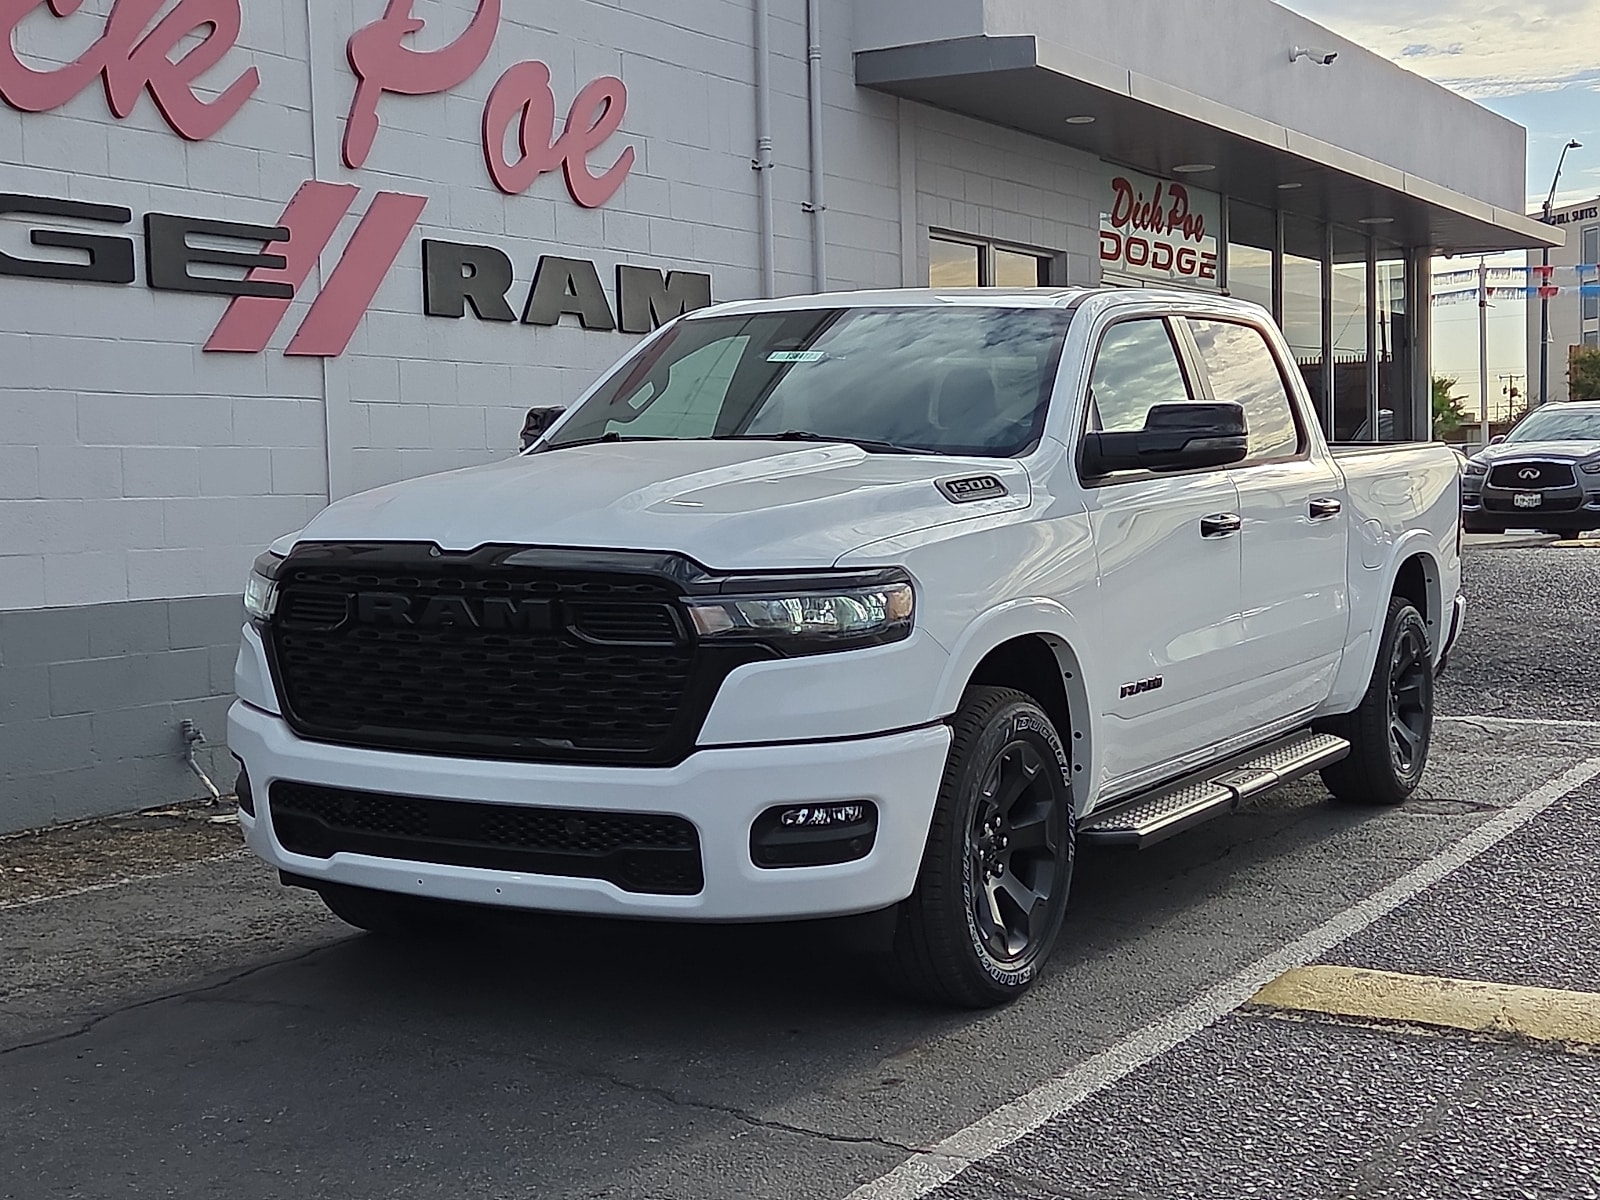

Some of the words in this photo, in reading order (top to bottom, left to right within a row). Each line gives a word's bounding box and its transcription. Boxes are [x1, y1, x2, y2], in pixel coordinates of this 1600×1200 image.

[1111, 177, 1165, 235] Dick
[1167, 183, 1206, 244] Poe
[1100, 230, 1218, 280] DODGE
[421, 238, 712, 334] RAM
[948, 478, 996, 493] 1500
[357, 592, 553, 630] RAM
[1119, 674, 1164, 699] RAM
